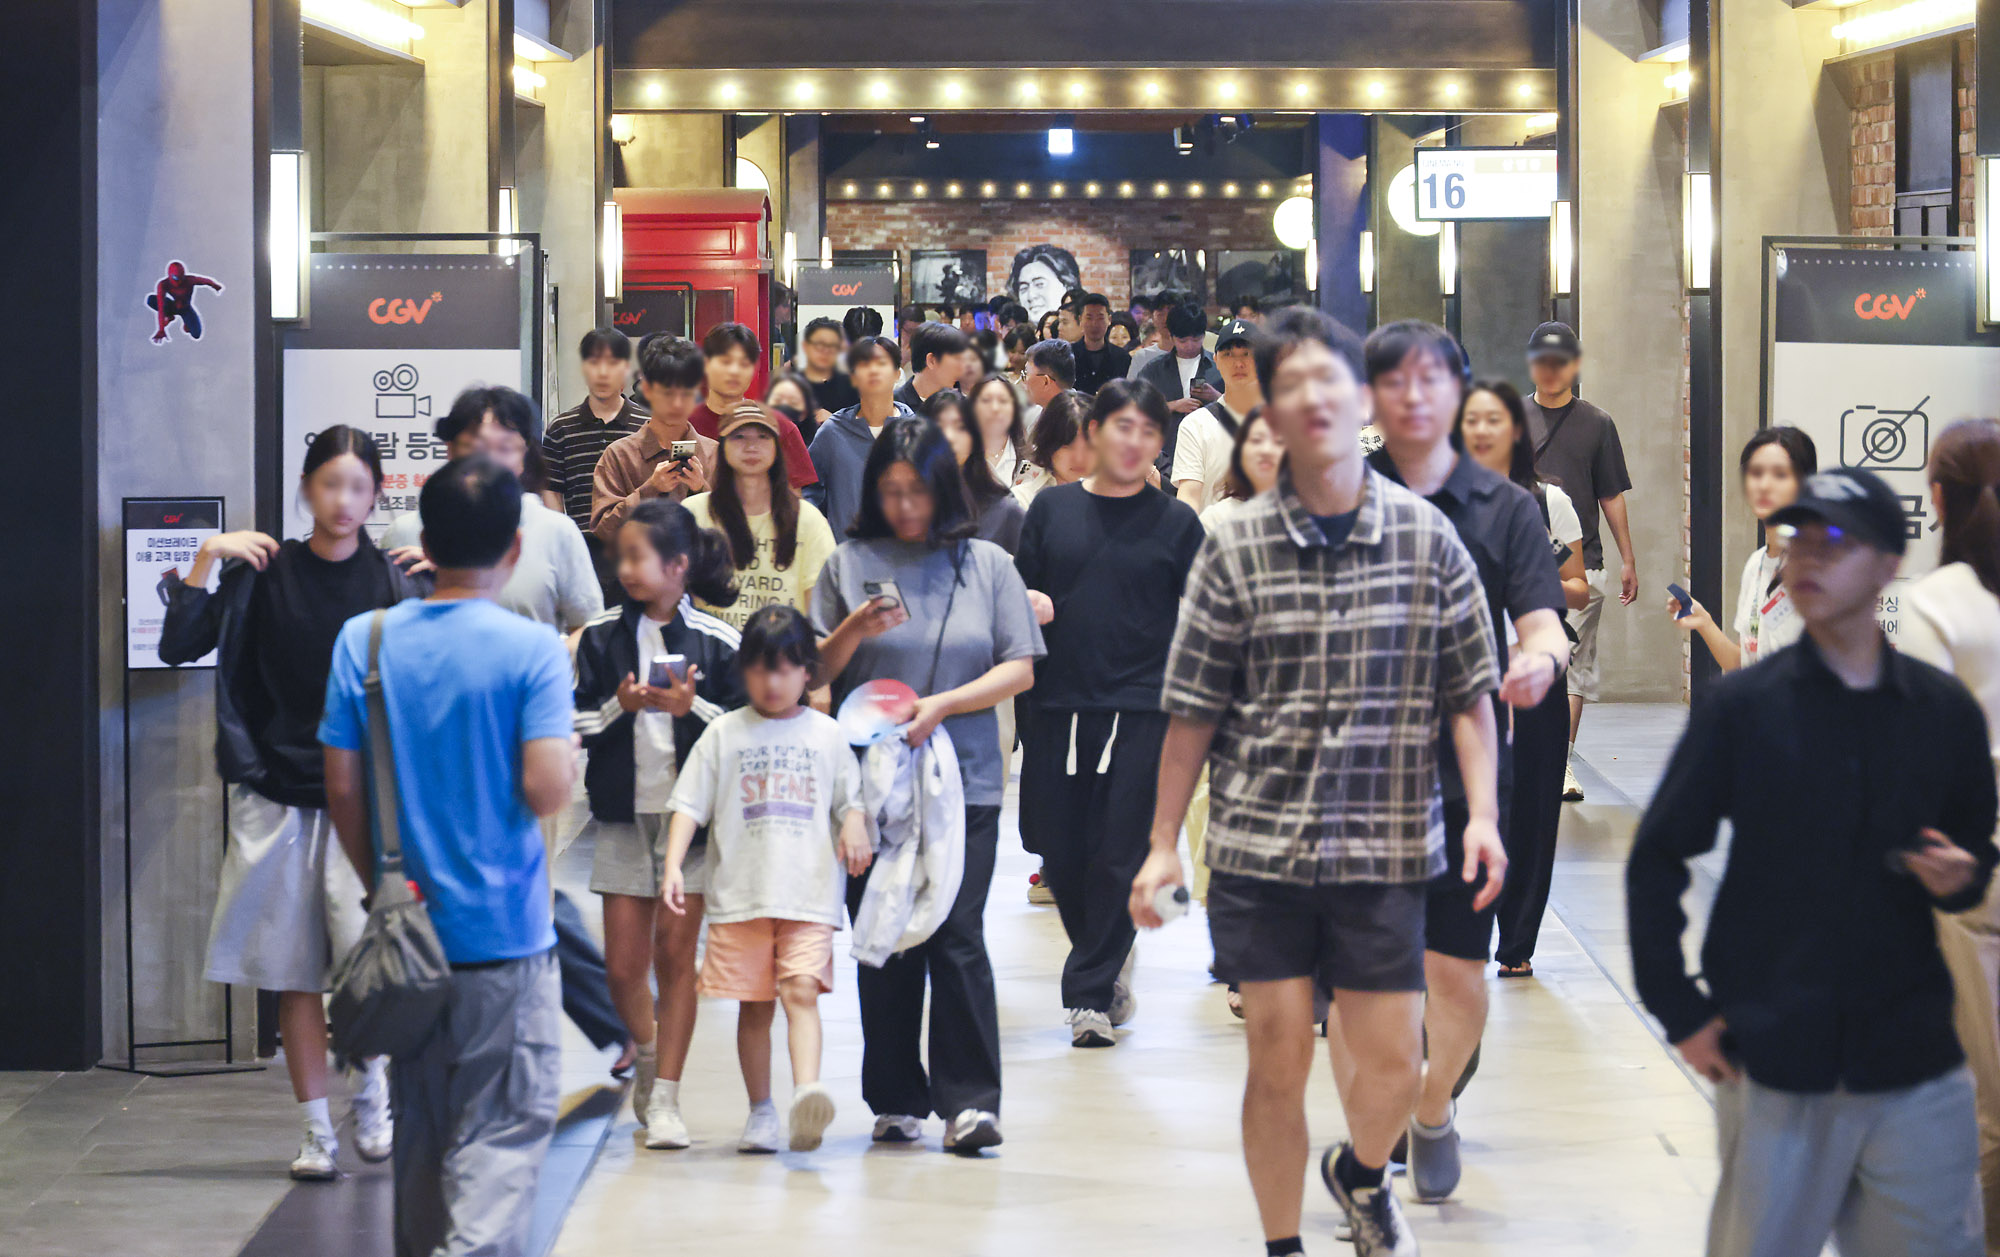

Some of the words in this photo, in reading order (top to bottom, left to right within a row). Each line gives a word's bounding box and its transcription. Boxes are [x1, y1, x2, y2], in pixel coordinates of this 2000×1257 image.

[1423, 173, 1466, 209] 16
[832, 284, 859, 296] CGV
[368, 297, 433, 325] CGV
[1854, 292, 1917, 321] CGV
